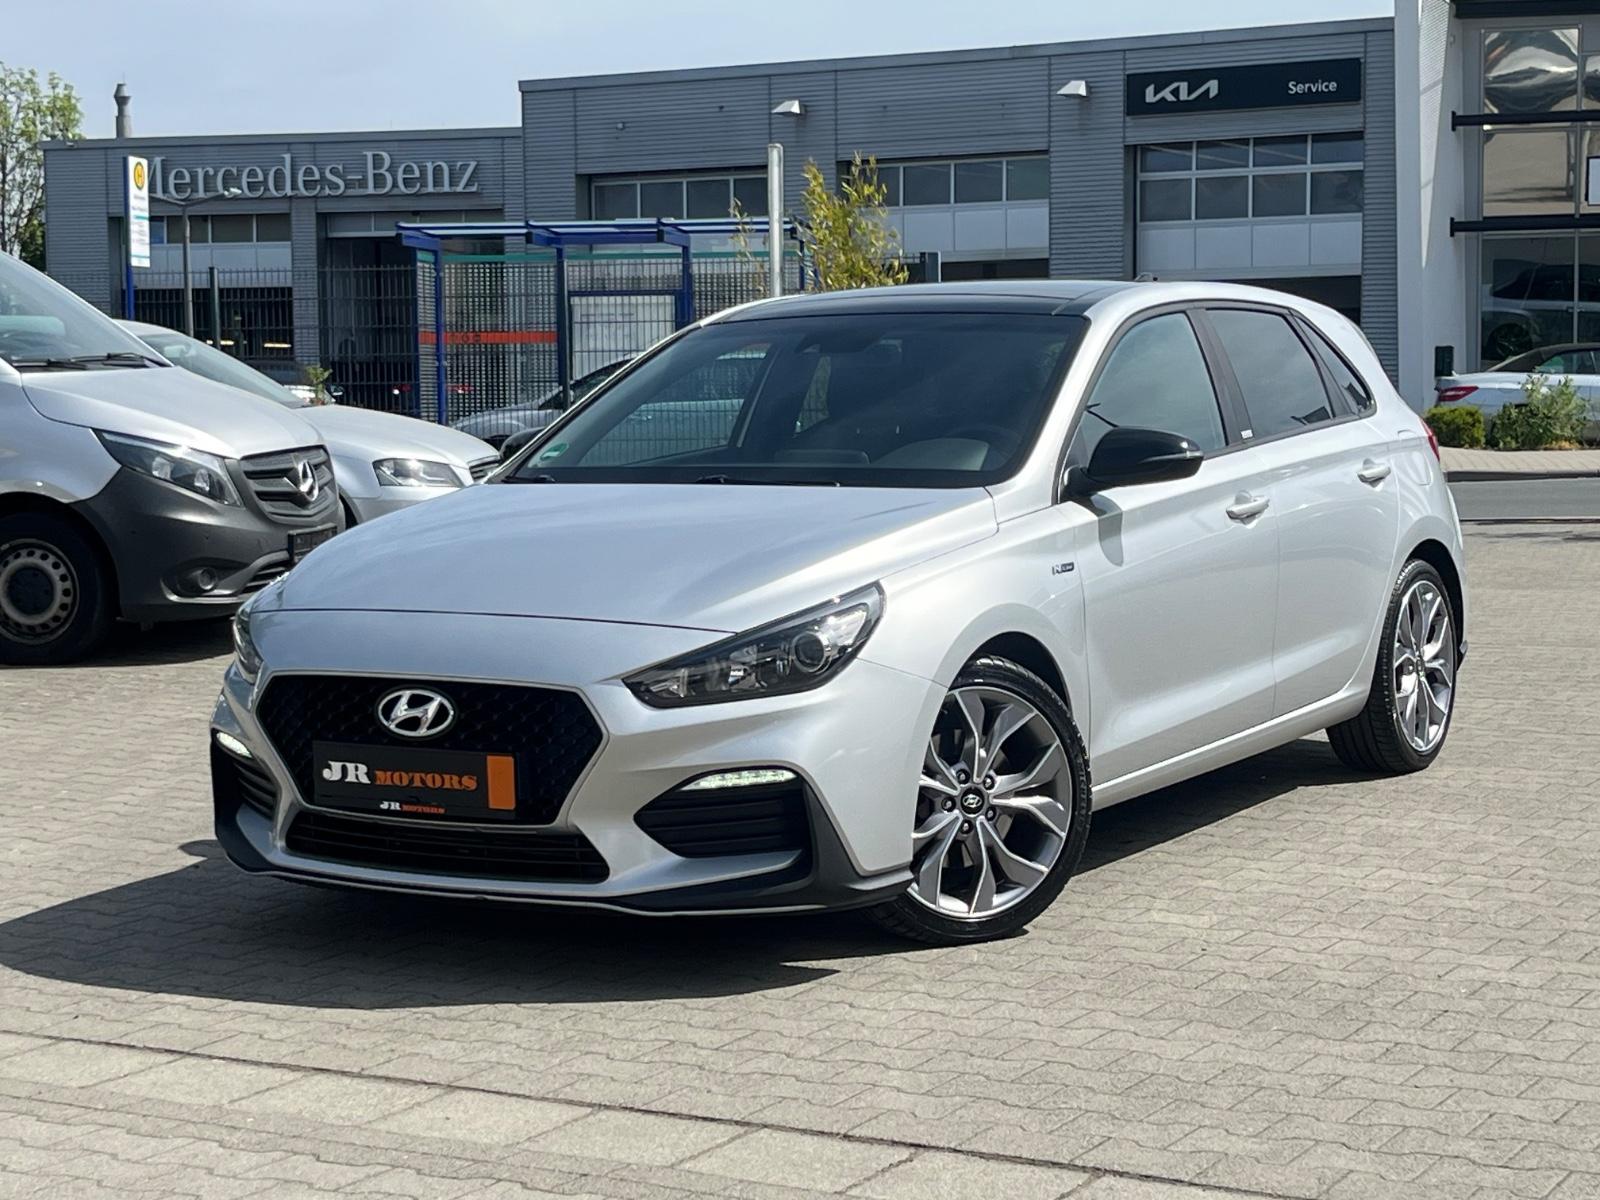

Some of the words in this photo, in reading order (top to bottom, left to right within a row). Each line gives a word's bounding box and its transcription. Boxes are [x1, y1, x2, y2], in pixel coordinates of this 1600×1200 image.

[1288, 79, 1338, 95] Service
[322, 760, 371, 784] JR
[374, 770, 478, 791] MOTORS
[380, 800, 401, 811] JR
